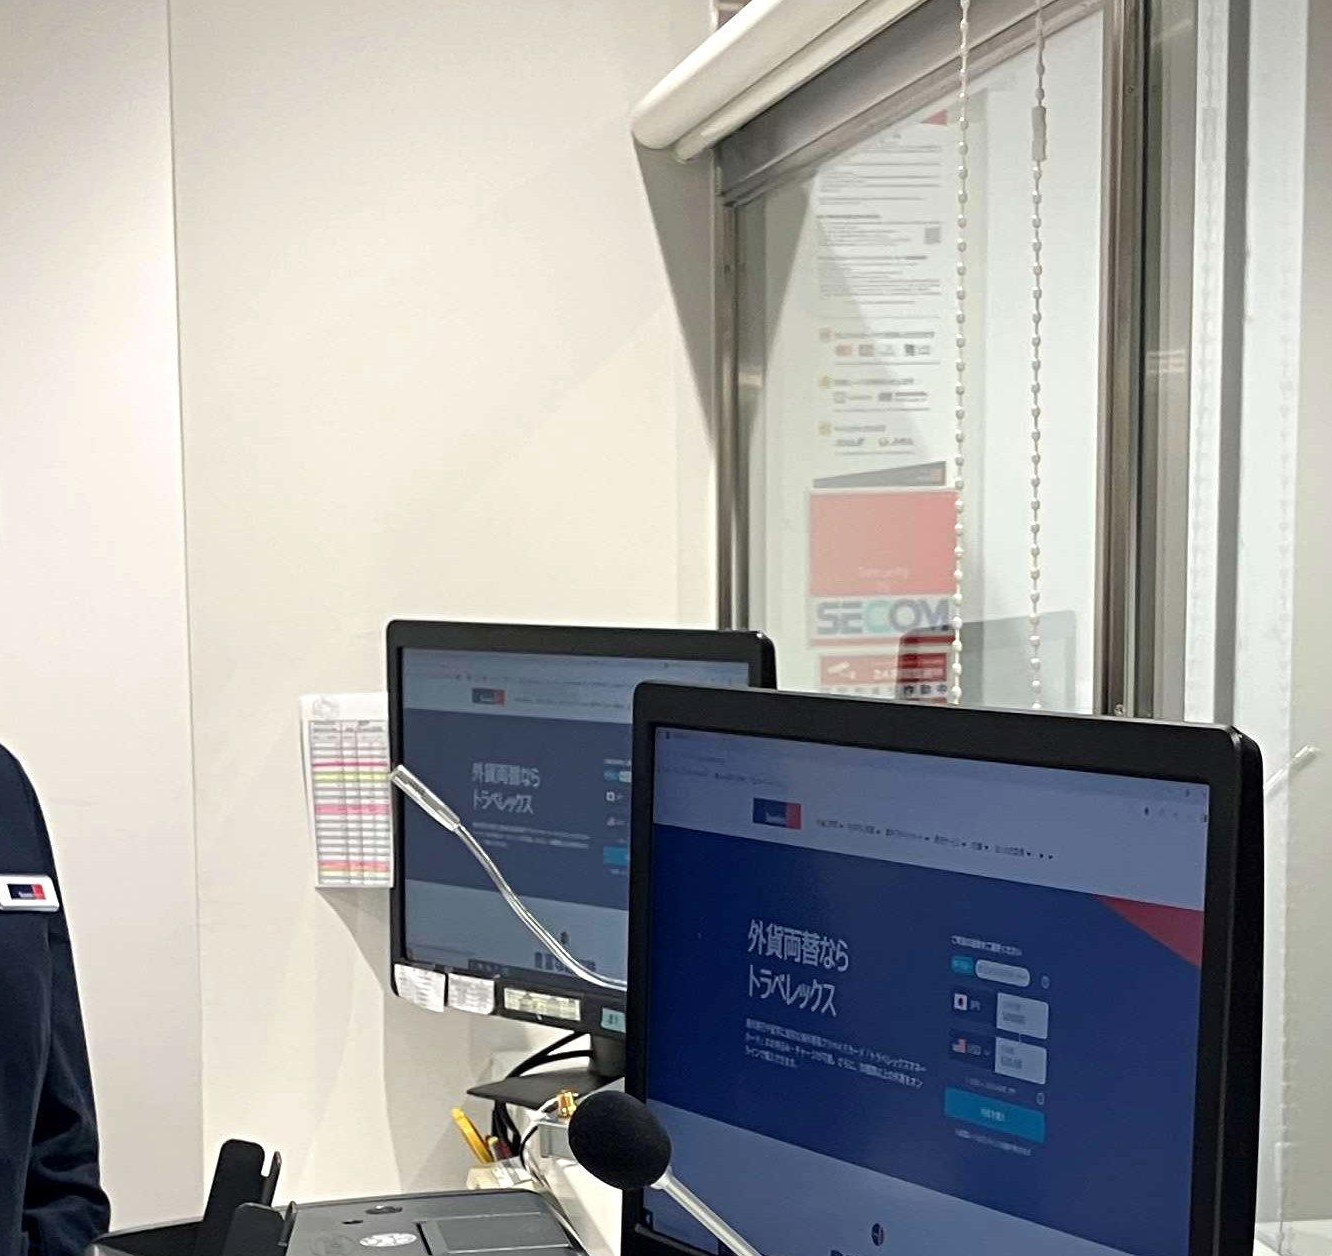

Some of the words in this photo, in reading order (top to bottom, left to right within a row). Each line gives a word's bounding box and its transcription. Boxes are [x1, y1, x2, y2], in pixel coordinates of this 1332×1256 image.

[816, 599, 950, 634] SECOM
[748, 918, 849, 972] 外貨両替なら
[748, 963, 837, 1018] トラベレックス
